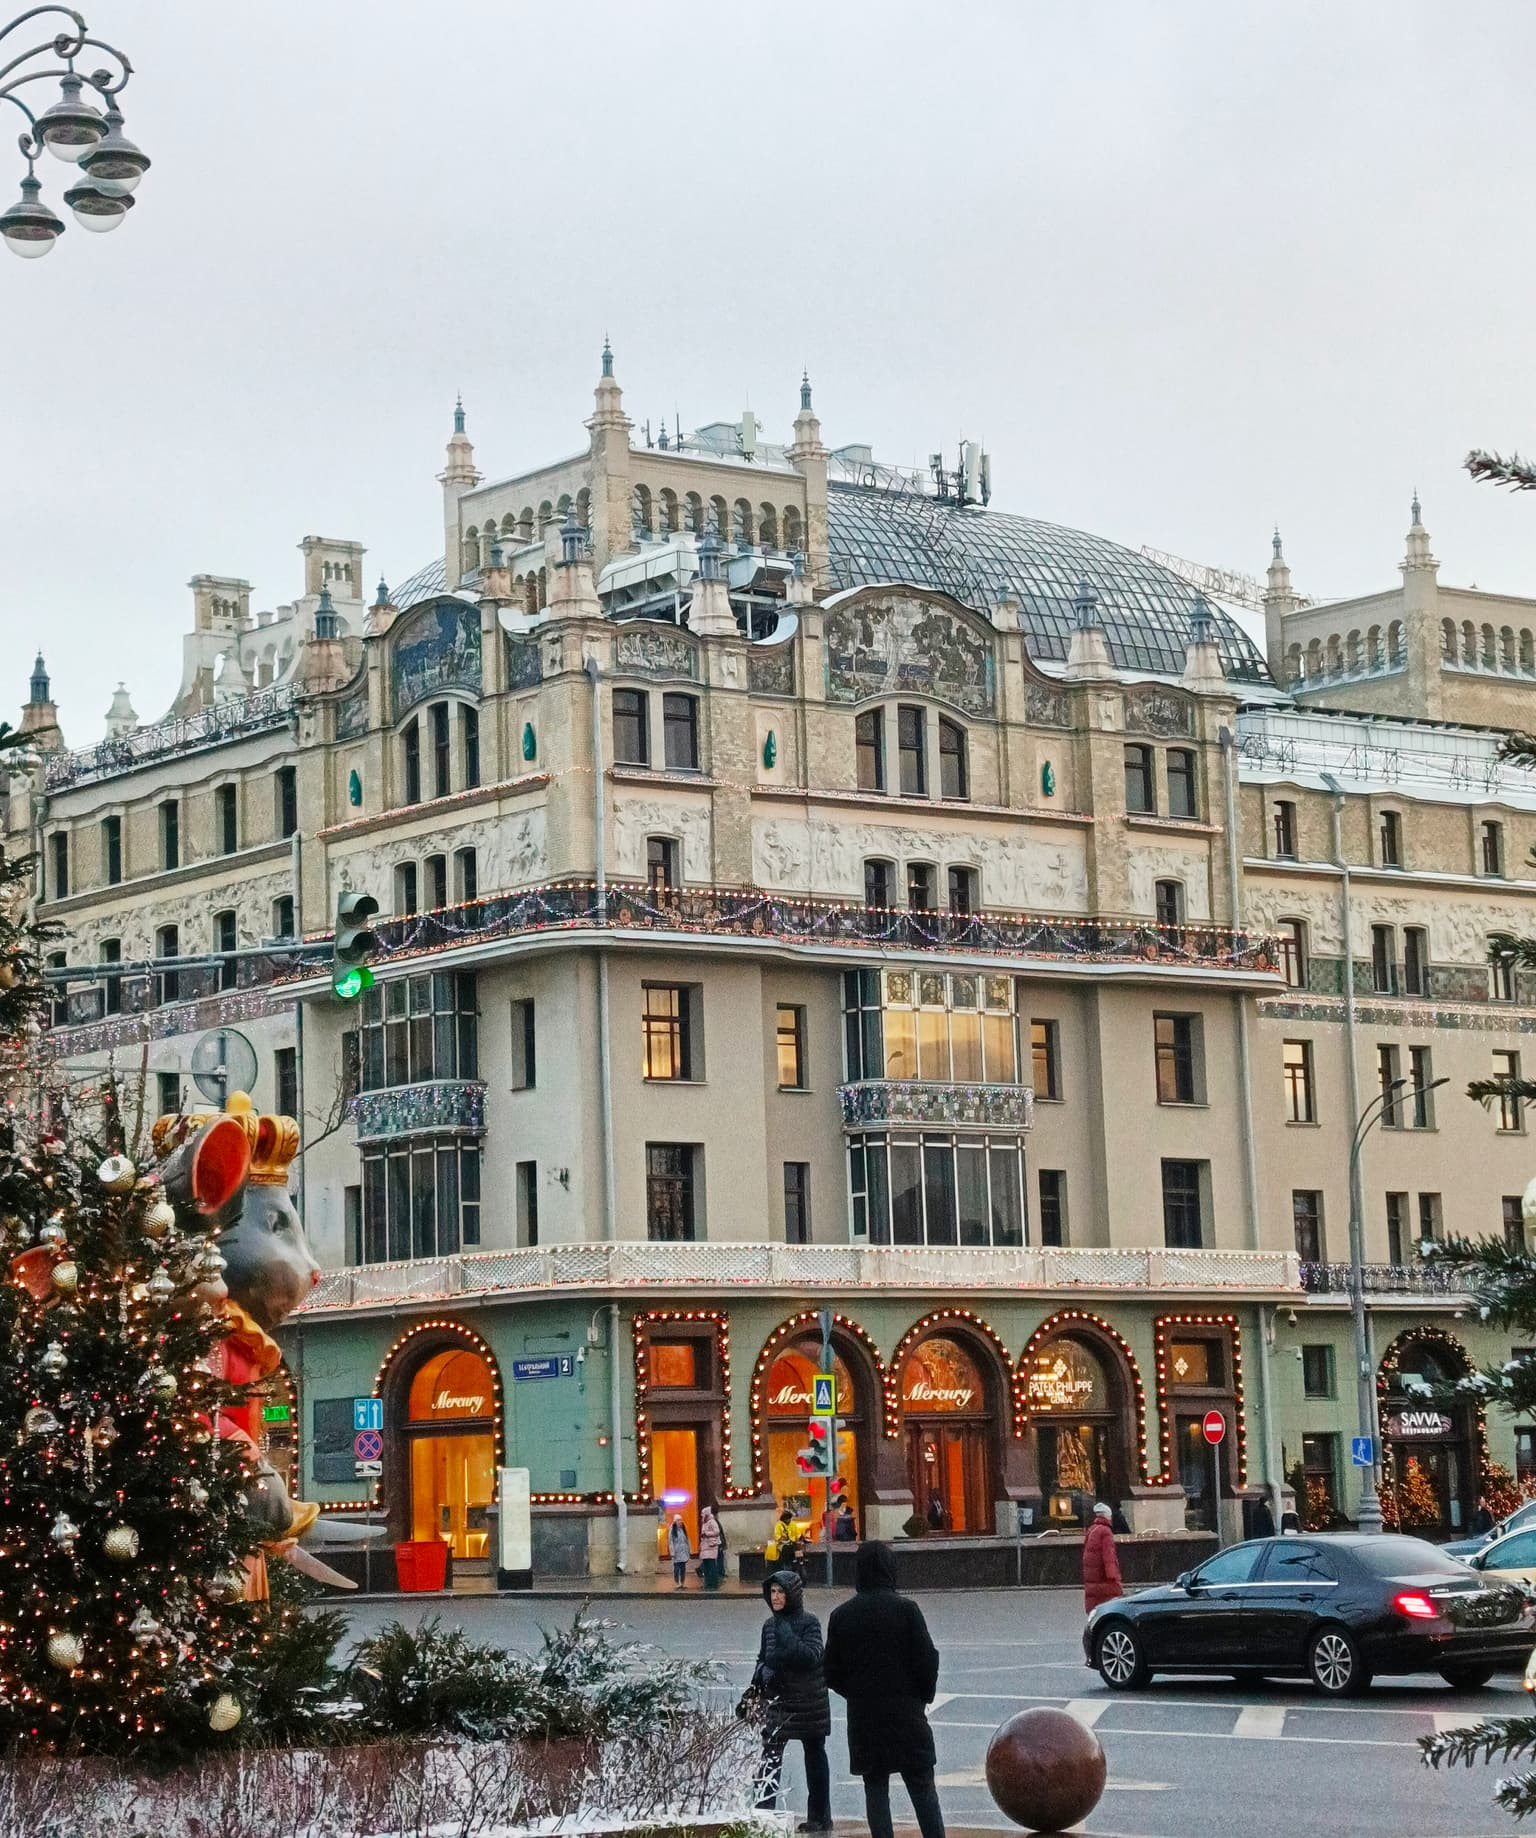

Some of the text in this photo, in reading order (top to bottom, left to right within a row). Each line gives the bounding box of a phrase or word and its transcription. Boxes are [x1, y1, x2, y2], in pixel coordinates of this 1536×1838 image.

[562, 1359, 569, 1372] 2
[902, 1381, 974, 1407] Mercury
[1029, 1380, 1093, 1393] PATEK PHILIPPE
[431, 1390, 485, 1414] Mercury
[1401, 1411, 1442, 1426] SAVVA
